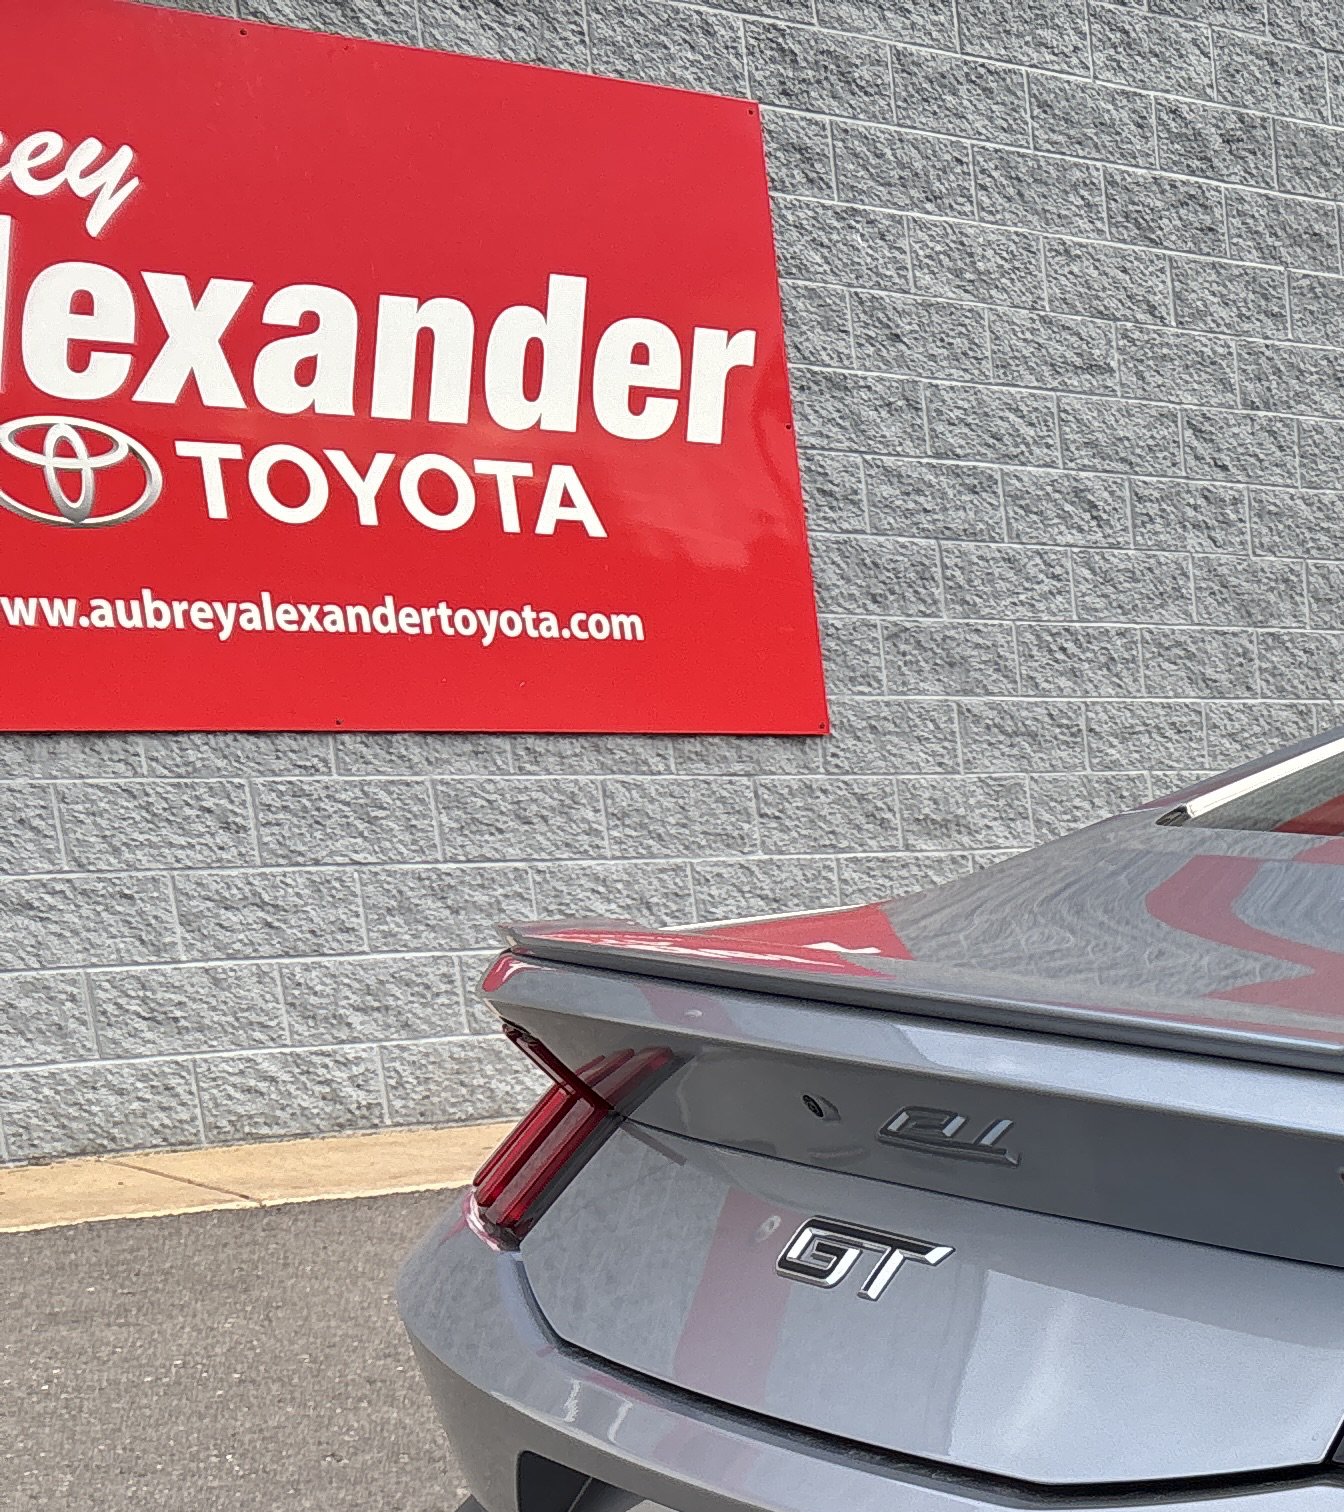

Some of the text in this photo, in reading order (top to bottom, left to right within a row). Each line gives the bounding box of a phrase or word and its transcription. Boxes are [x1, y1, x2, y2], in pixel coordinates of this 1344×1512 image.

[0, 130, 140, 238] ey
[0, 213, 757, 445] exander
[174, 440, 607, 539] TOYOTA
[775, 1214, 956, 1302] GT
